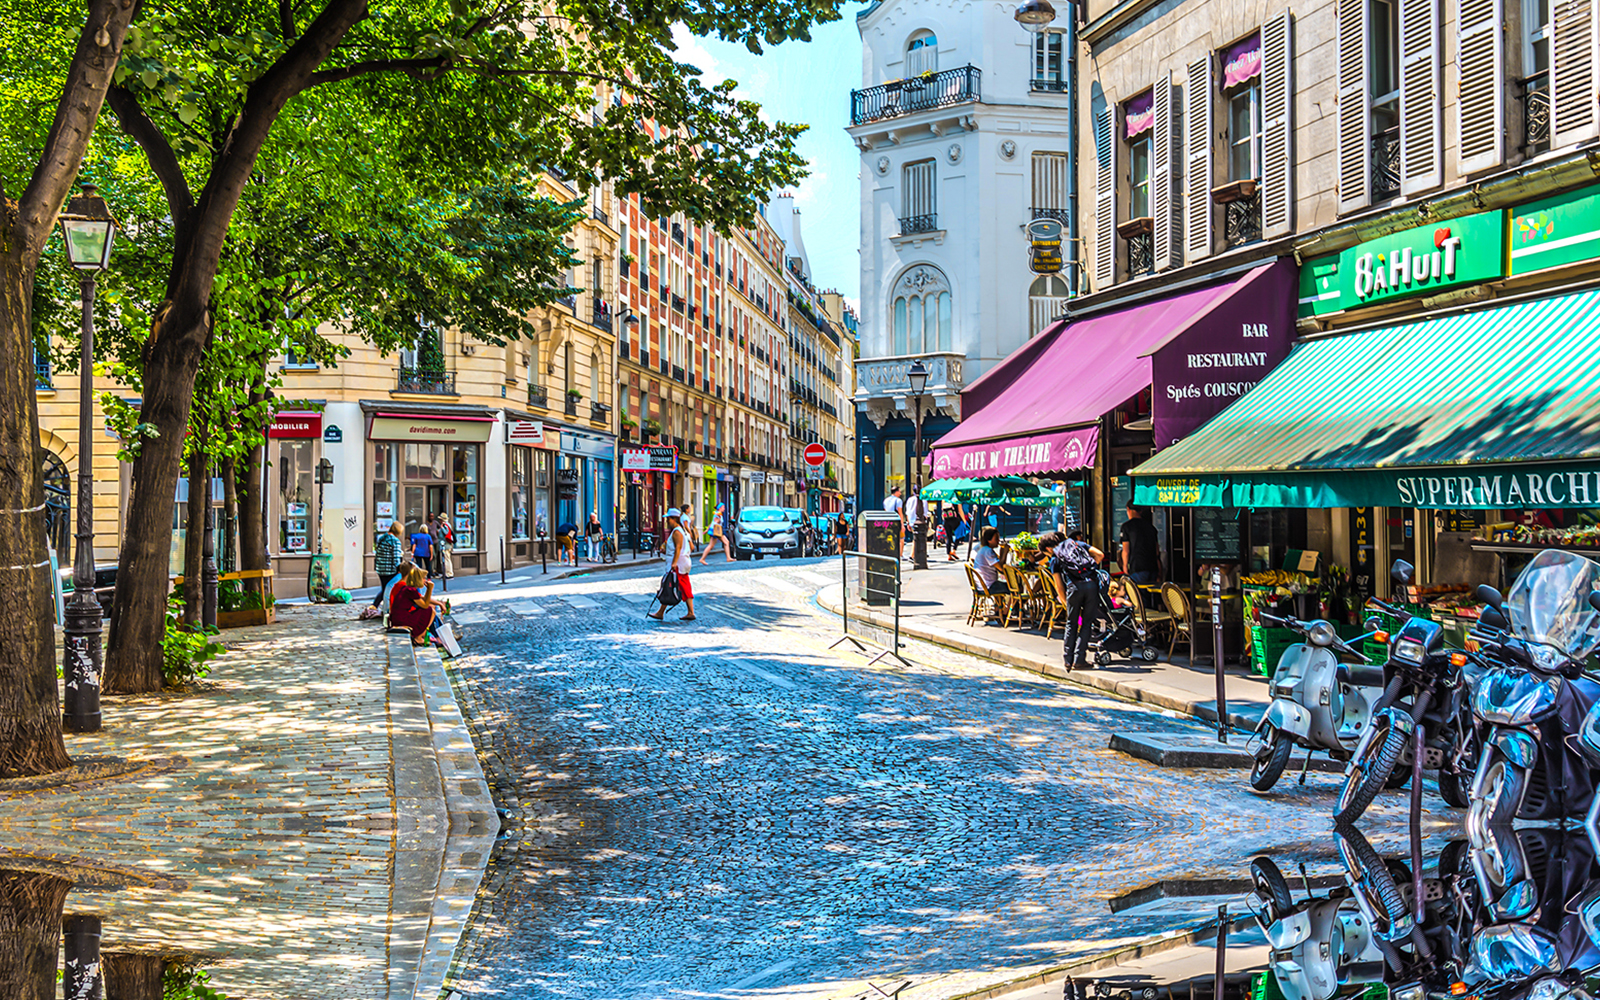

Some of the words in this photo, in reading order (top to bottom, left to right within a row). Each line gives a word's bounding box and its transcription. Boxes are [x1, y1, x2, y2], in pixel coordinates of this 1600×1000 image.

[1242, 323, 1269, 338] BAR
[1187, 352, 1267, 368] RESTAURANT
[1166, 384, 1201, 403] Sptés
[1204, 381, 1257, 398] COUSCO
[263, 423, 309, 431] MOBILIER
[962, 450, 986, 472] CAFE
[1003, 441, 1052, 467] THEATRE
[1156, 478, 1186, 491] OUVERT
[1189, 478, 1200, 491] DE
[1396, 471, 1600, 506] SUPERMARCH
